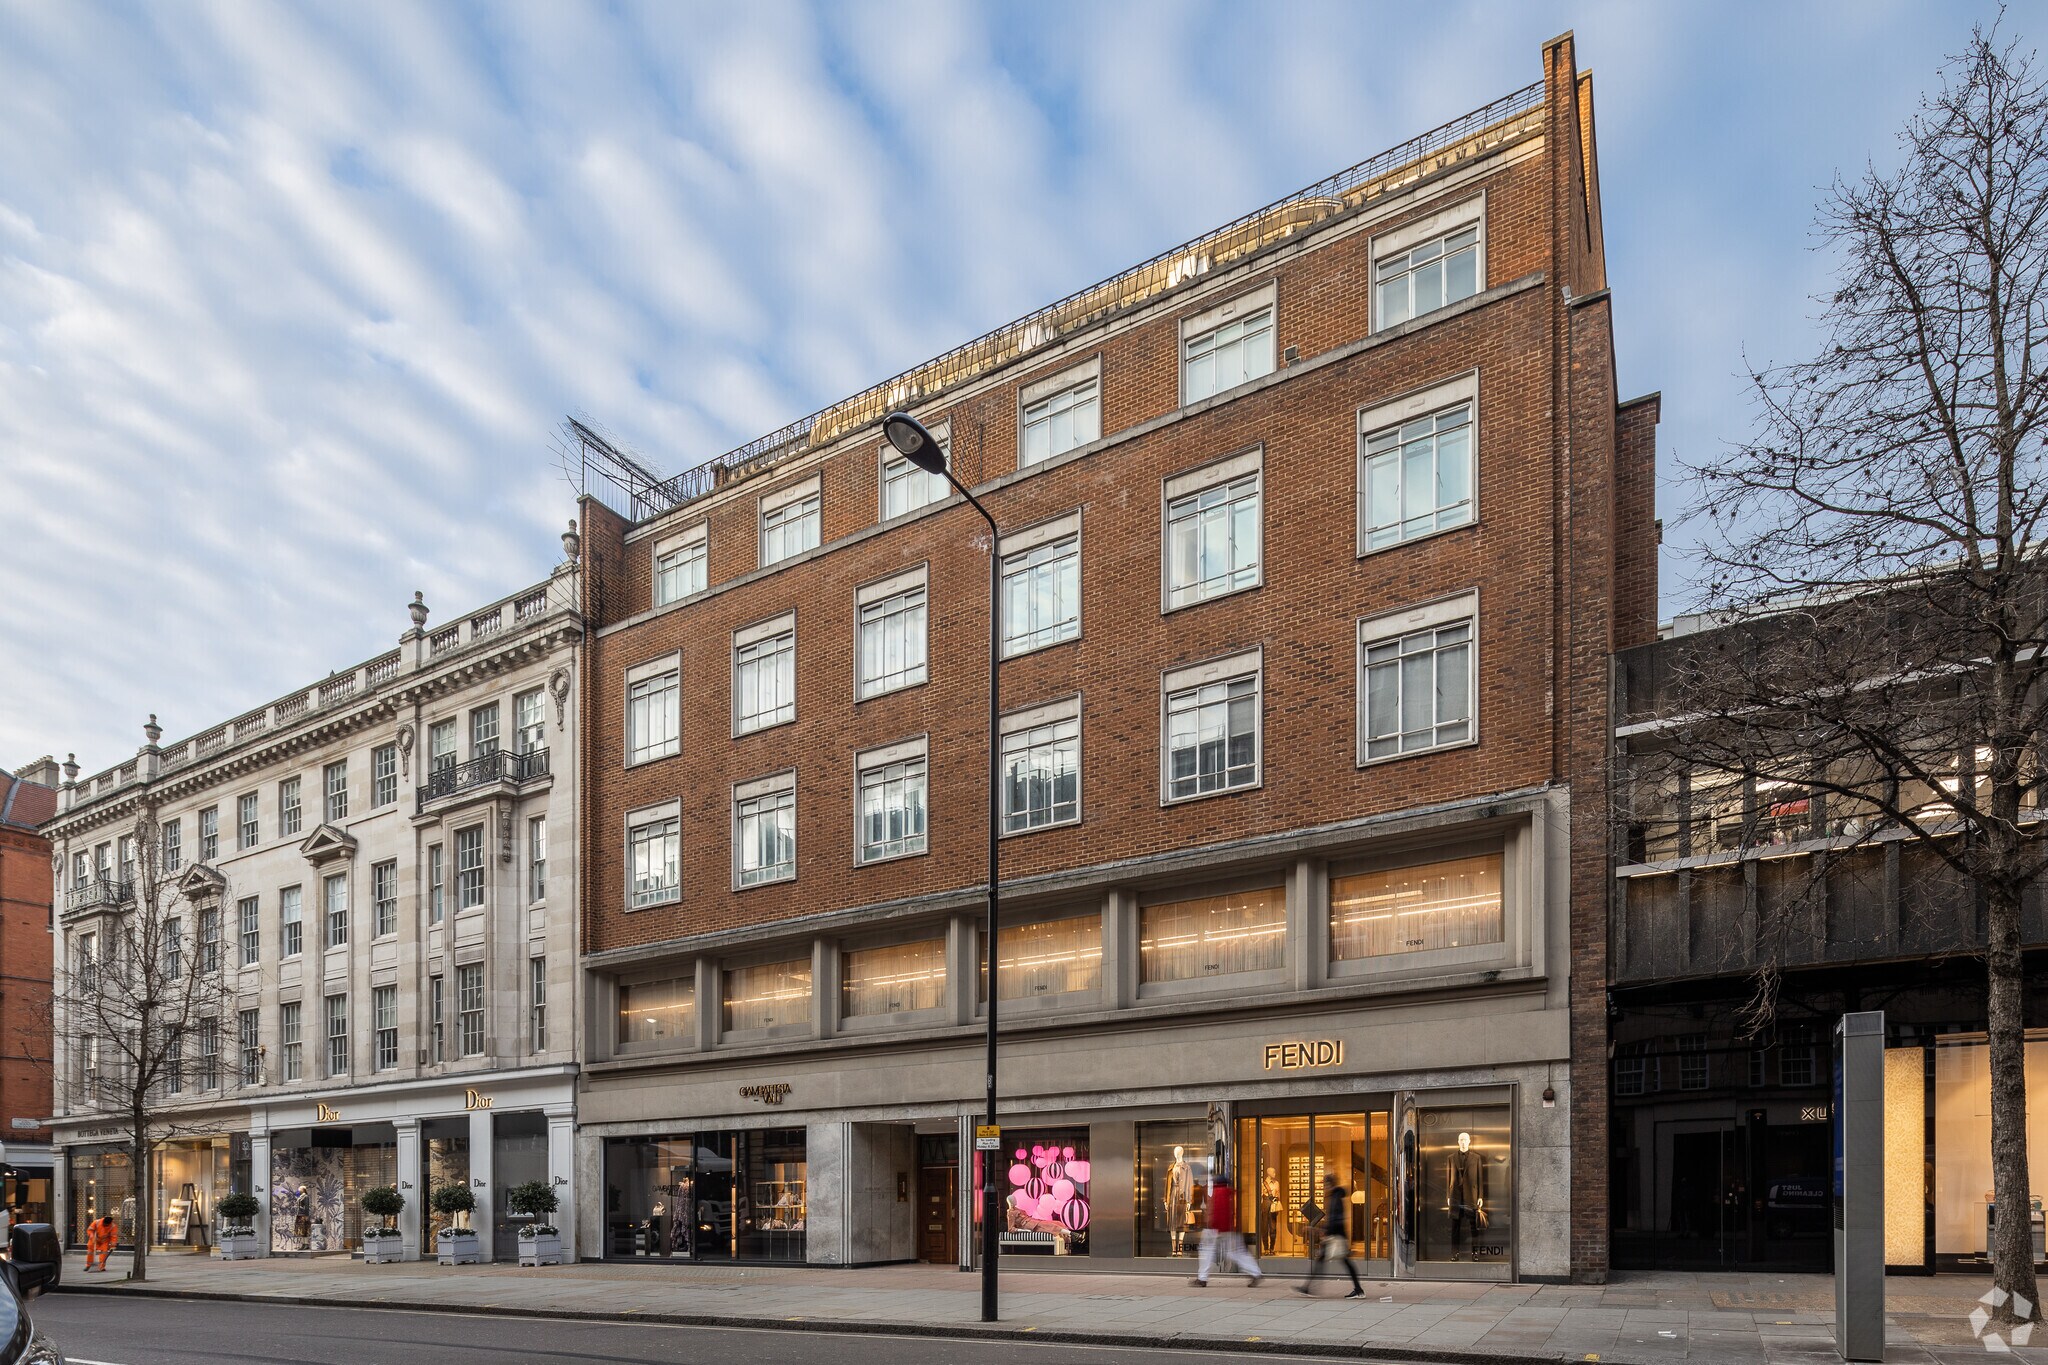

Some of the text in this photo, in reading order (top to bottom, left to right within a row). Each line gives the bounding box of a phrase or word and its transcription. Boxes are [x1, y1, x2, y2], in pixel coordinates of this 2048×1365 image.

[1265, 1040, 1343, 1069] FENDI
[465, 1090, 494, 1110] Dior
[316, 1104, 340, 1122] Dior
[77, 1128, 119, 1137] BOTTEGA VENETA
[402, 1181, 413, 1189] Dior
[474, 1179, 486, 1187] Dior
[555, 1176, 568, 1185] Dior
[1473, 1246, 1504, 1255] FENDI
